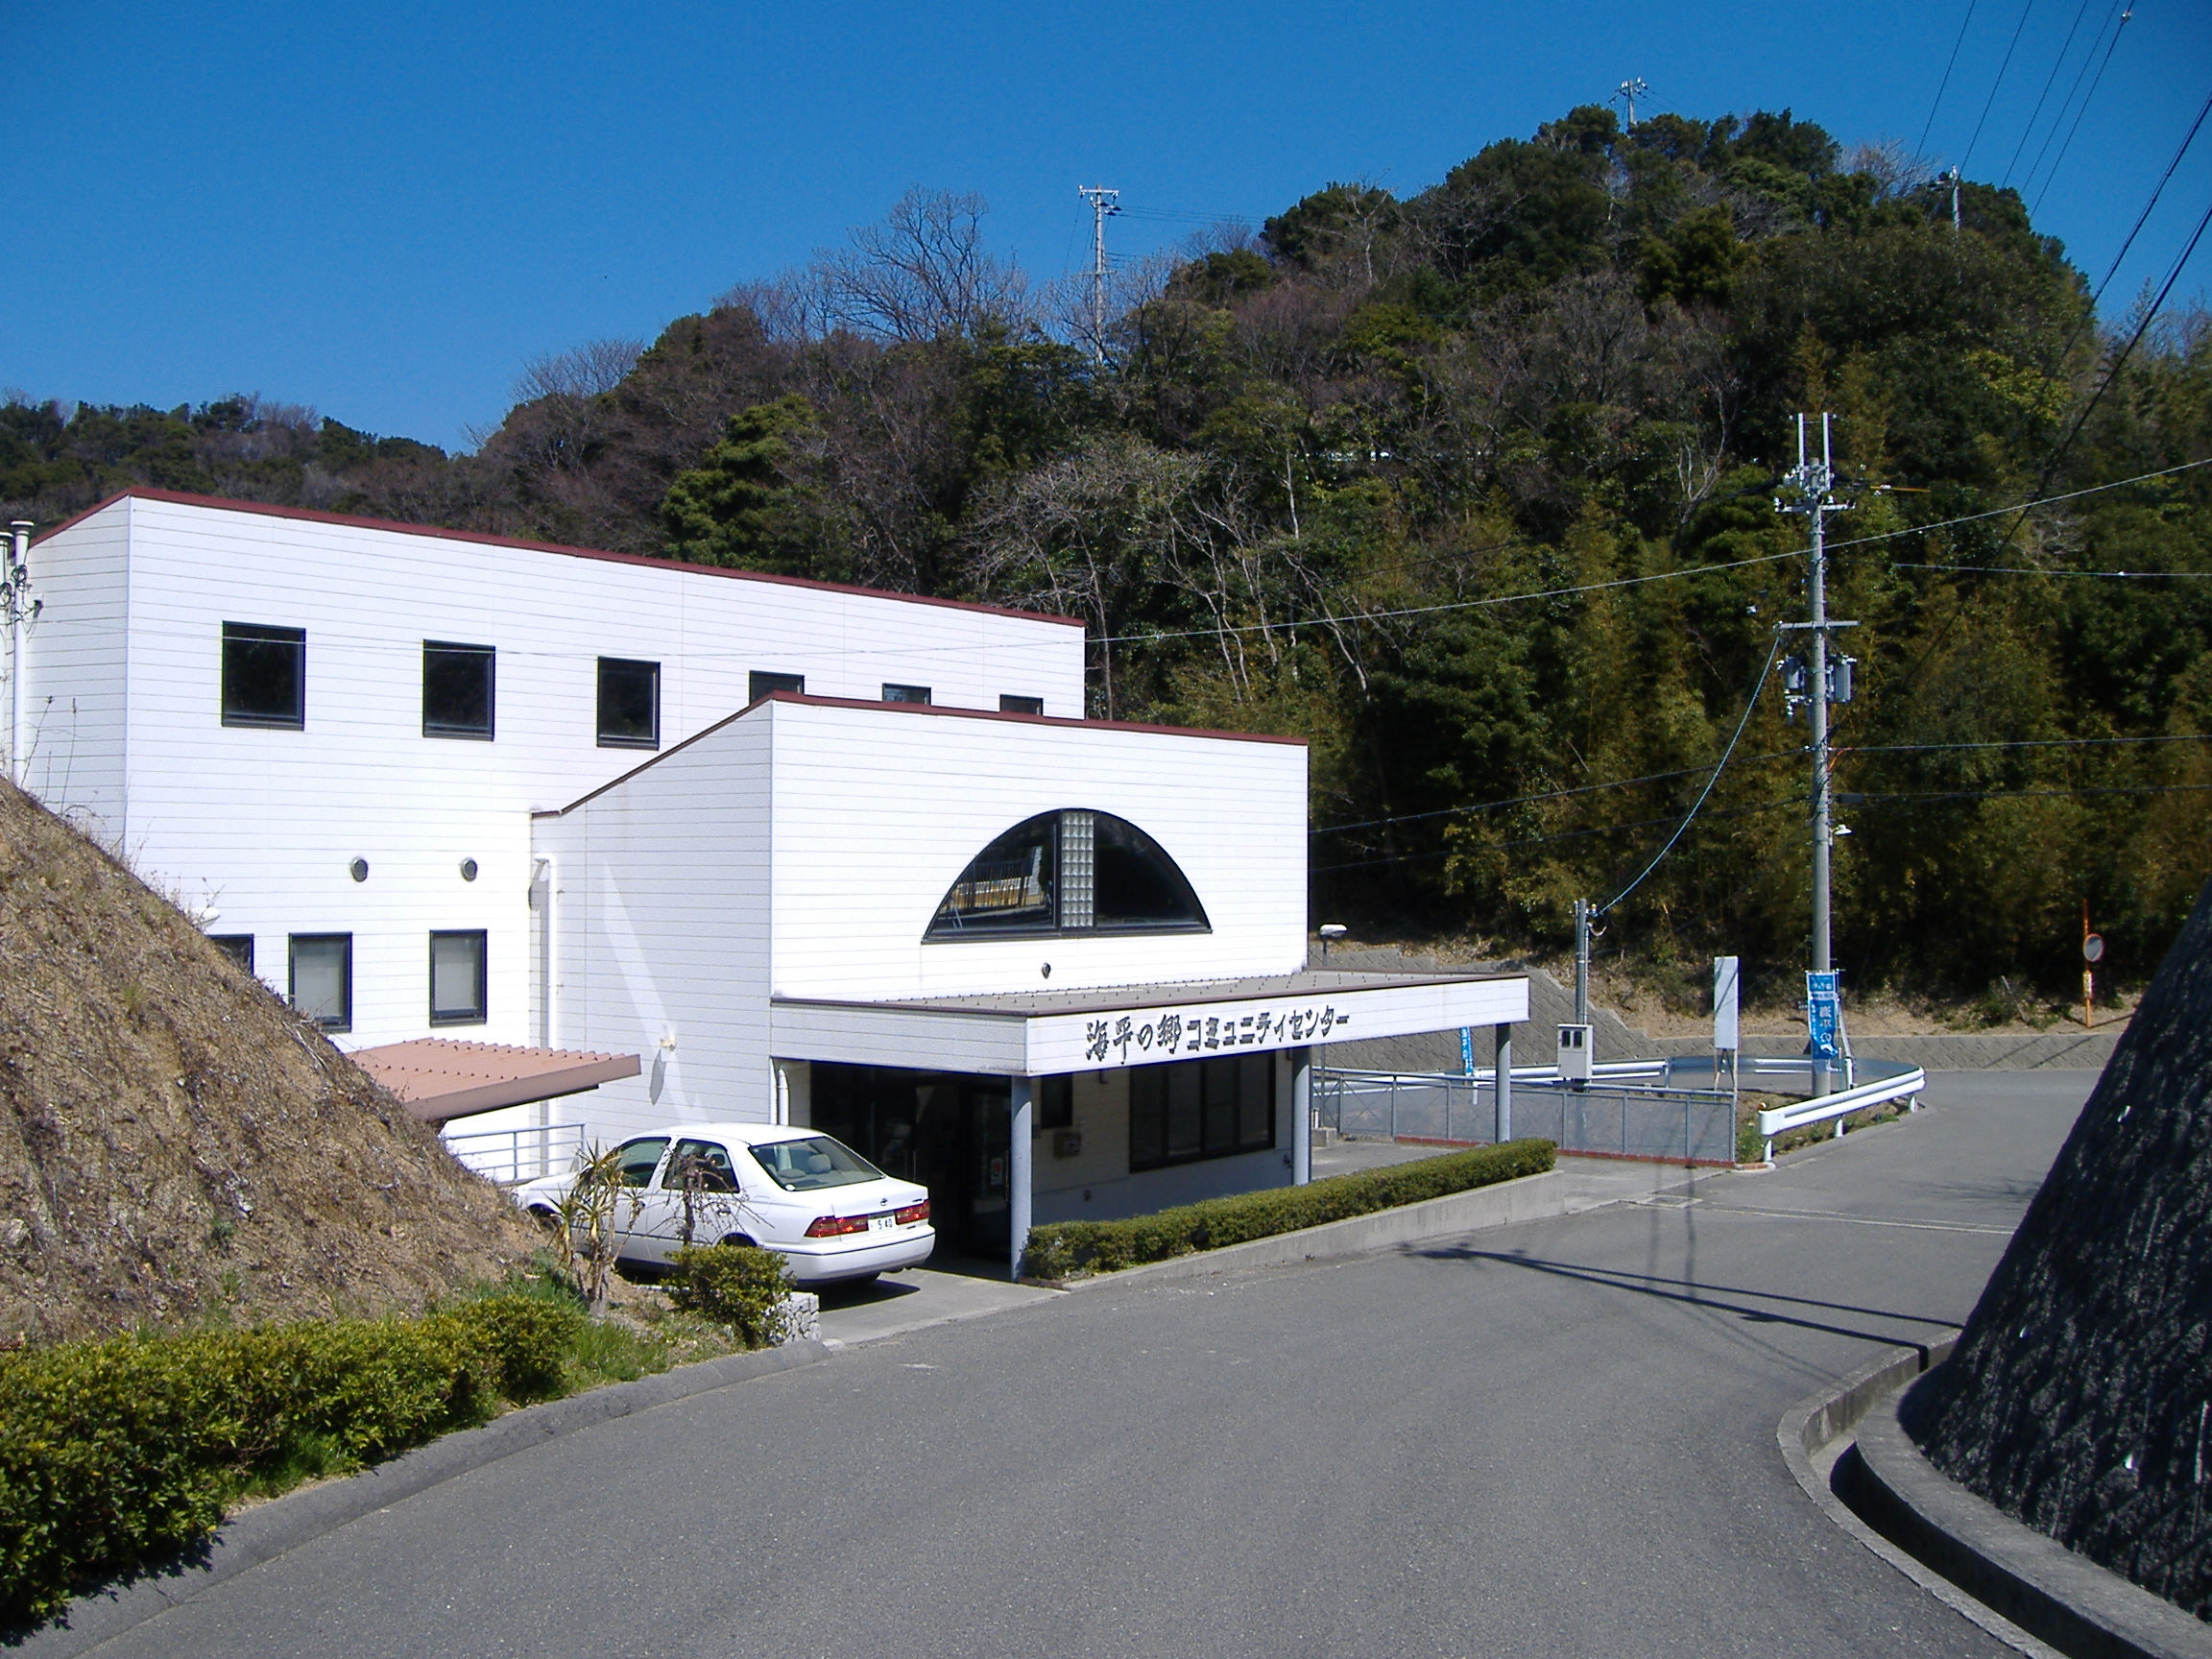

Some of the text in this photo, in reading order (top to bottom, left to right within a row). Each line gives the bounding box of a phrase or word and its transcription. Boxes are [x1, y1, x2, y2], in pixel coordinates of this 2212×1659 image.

[1086, 1004, 1350, 1065] 海平の郷コミュニティセンター
